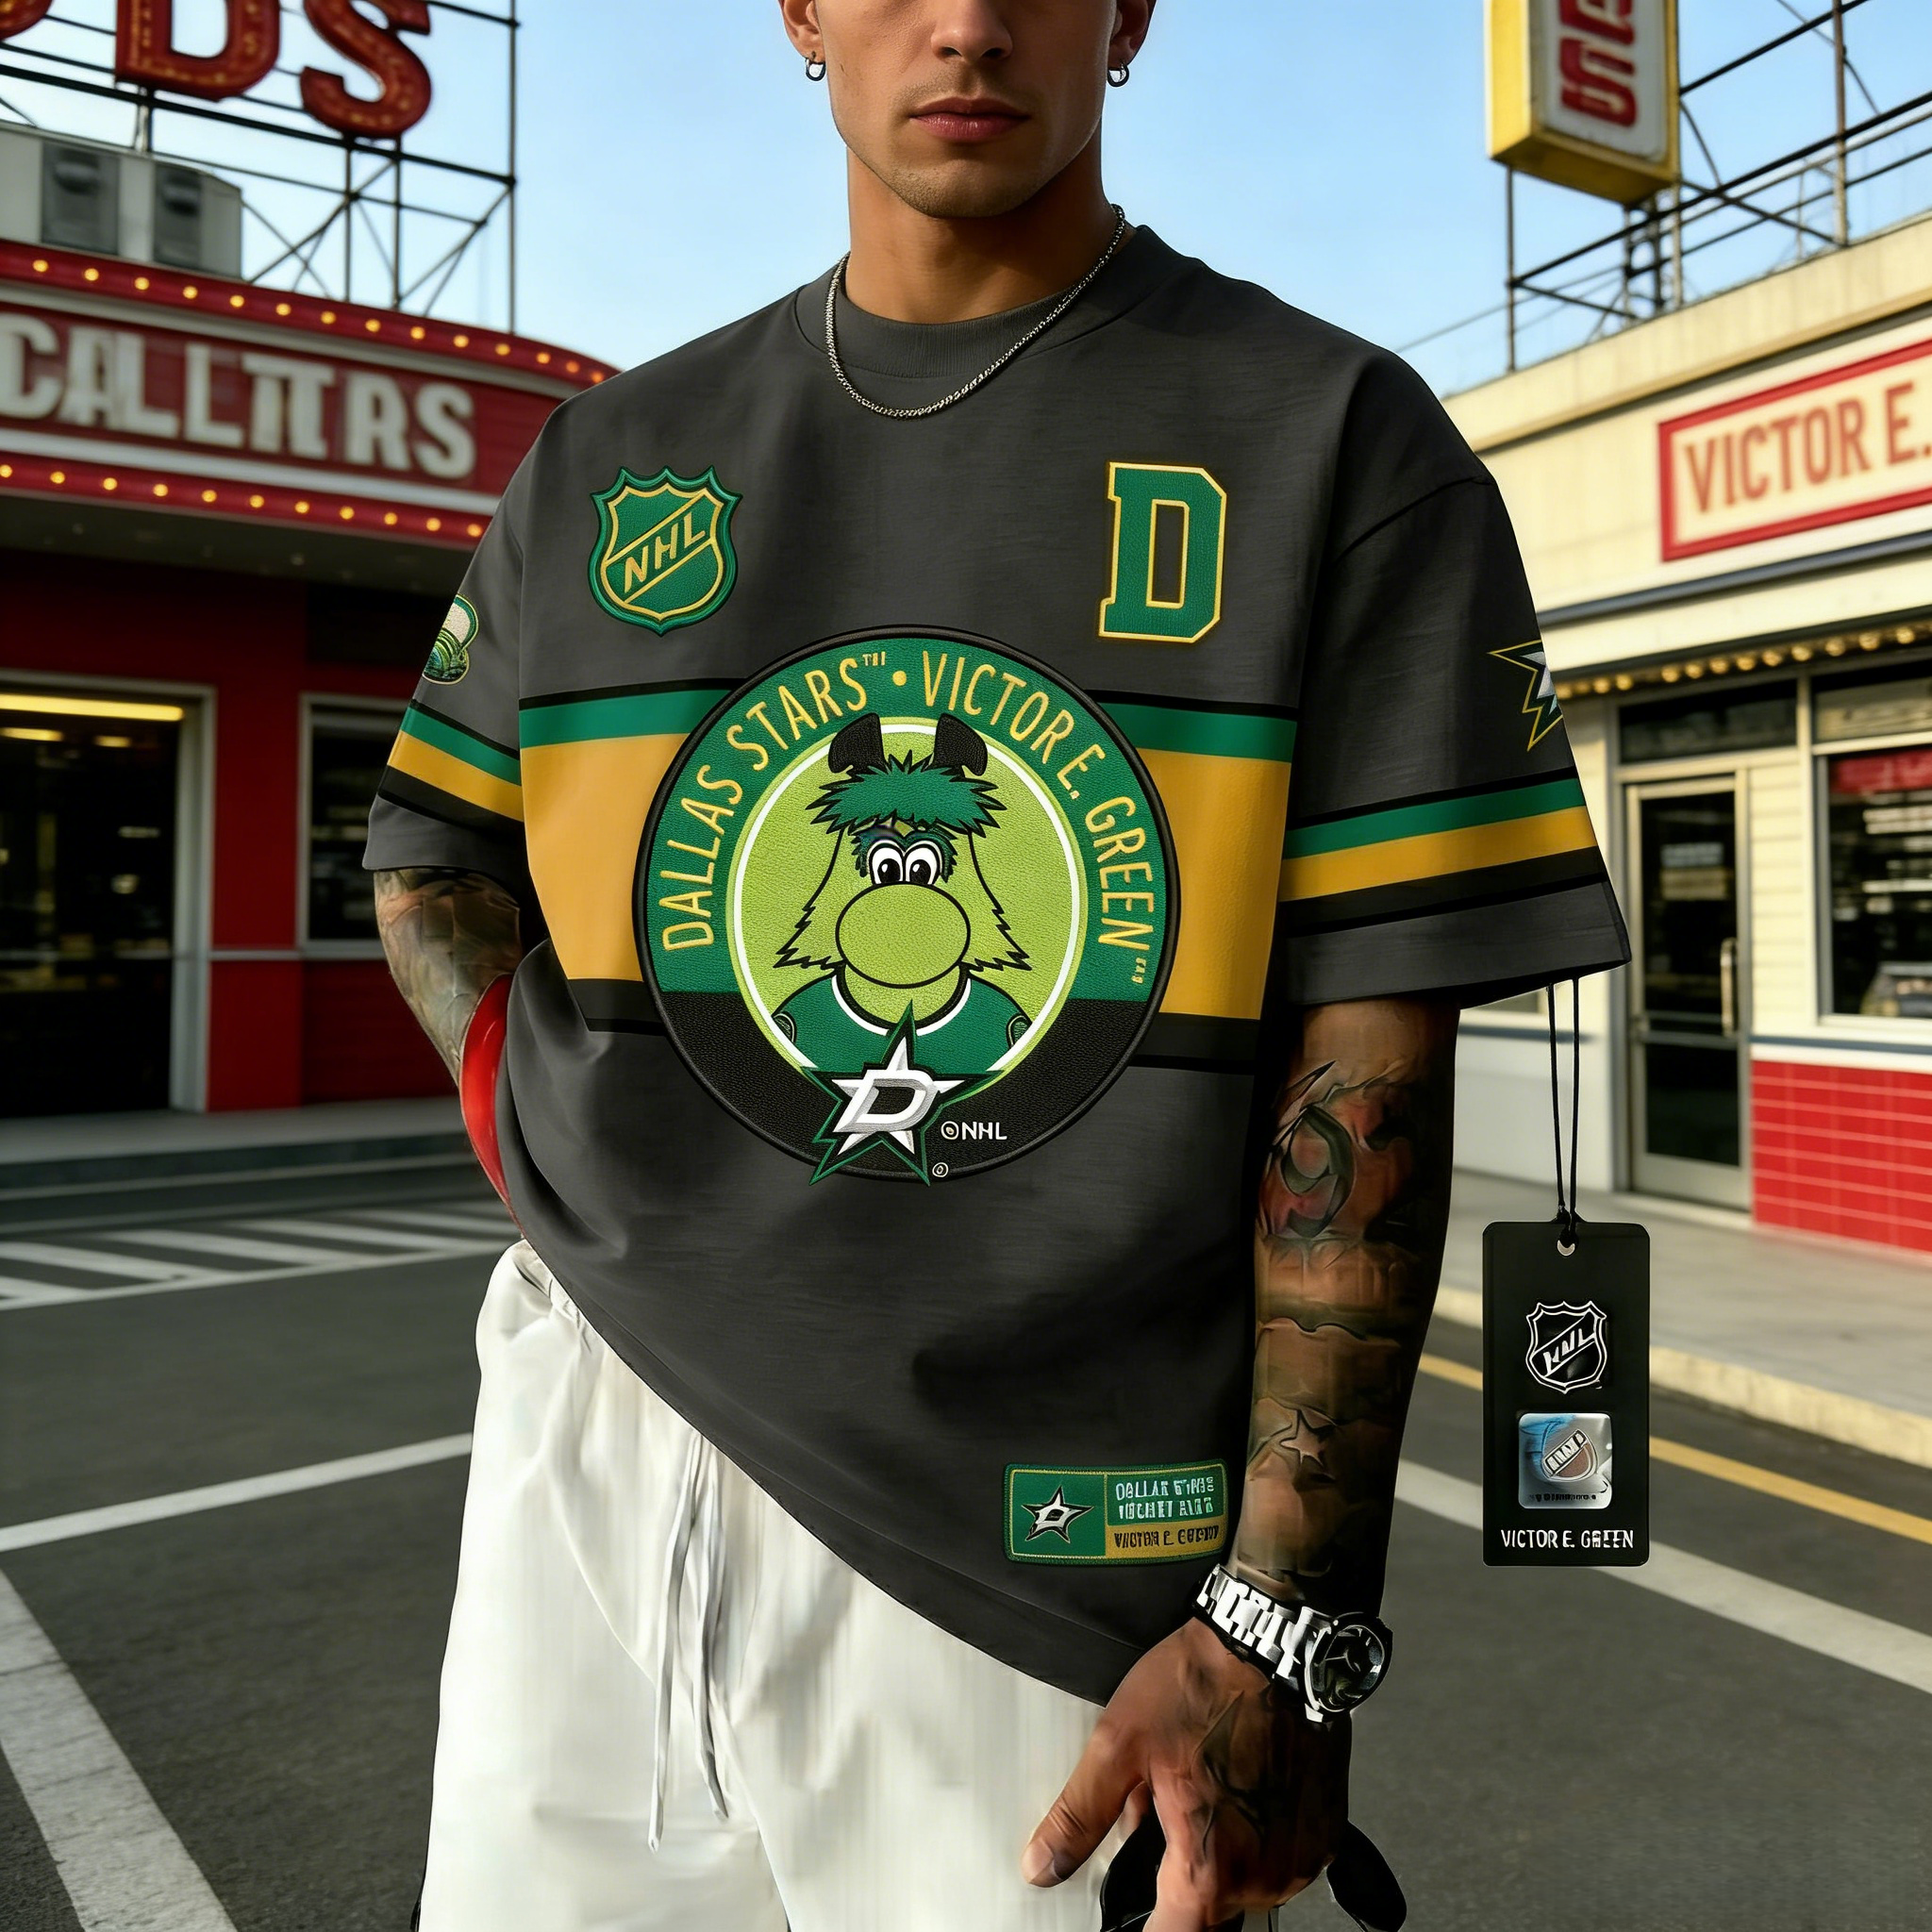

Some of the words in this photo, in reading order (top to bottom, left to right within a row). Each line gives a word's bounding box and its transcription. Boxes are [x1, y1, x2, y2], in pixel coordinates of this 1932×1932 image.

[0, 0, 432, 136] DS
[1685, 397, 1871, 513] VICTOR
[1885, 380, 1931, 465] E.
[625, 511, 707, 593] NHL
[1099, 462, 1226, 643] D
[658, 764, 743, 951] DALLAS
[923, 650, 1074, 765] VICTOR
[1501, 1529, 1557, 1549] VICTOR
